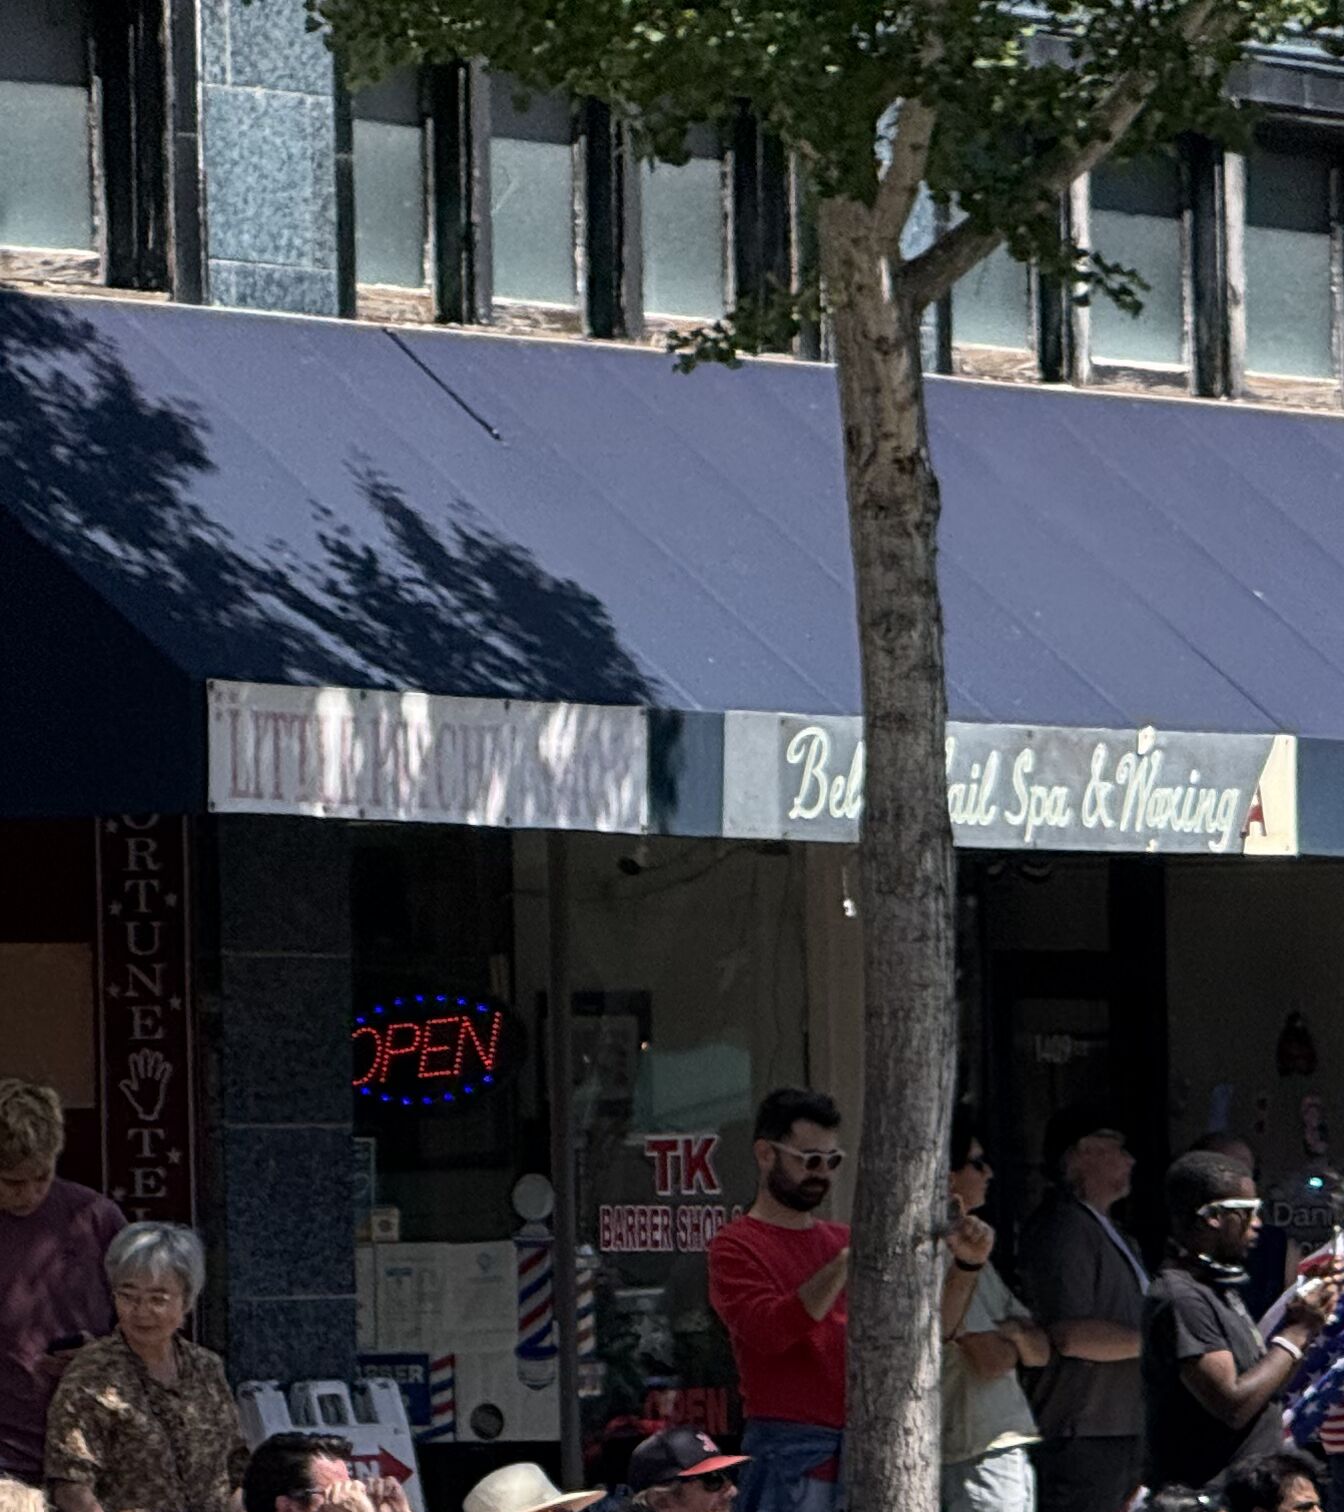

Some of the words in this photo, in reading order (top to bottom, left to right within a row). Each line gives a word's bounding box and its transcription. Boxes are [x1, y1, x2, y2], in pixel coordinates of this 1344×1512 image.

[944, 736, 998, 825] ail
[1006, 748, 1069, 842] Spa
[1082, 742, 1117, 828] &
[1117, 749, 1241, 853] Waxing
[645, 1134, 722, 1195] TK
[600, 1205, 673, 1251] BARBER
